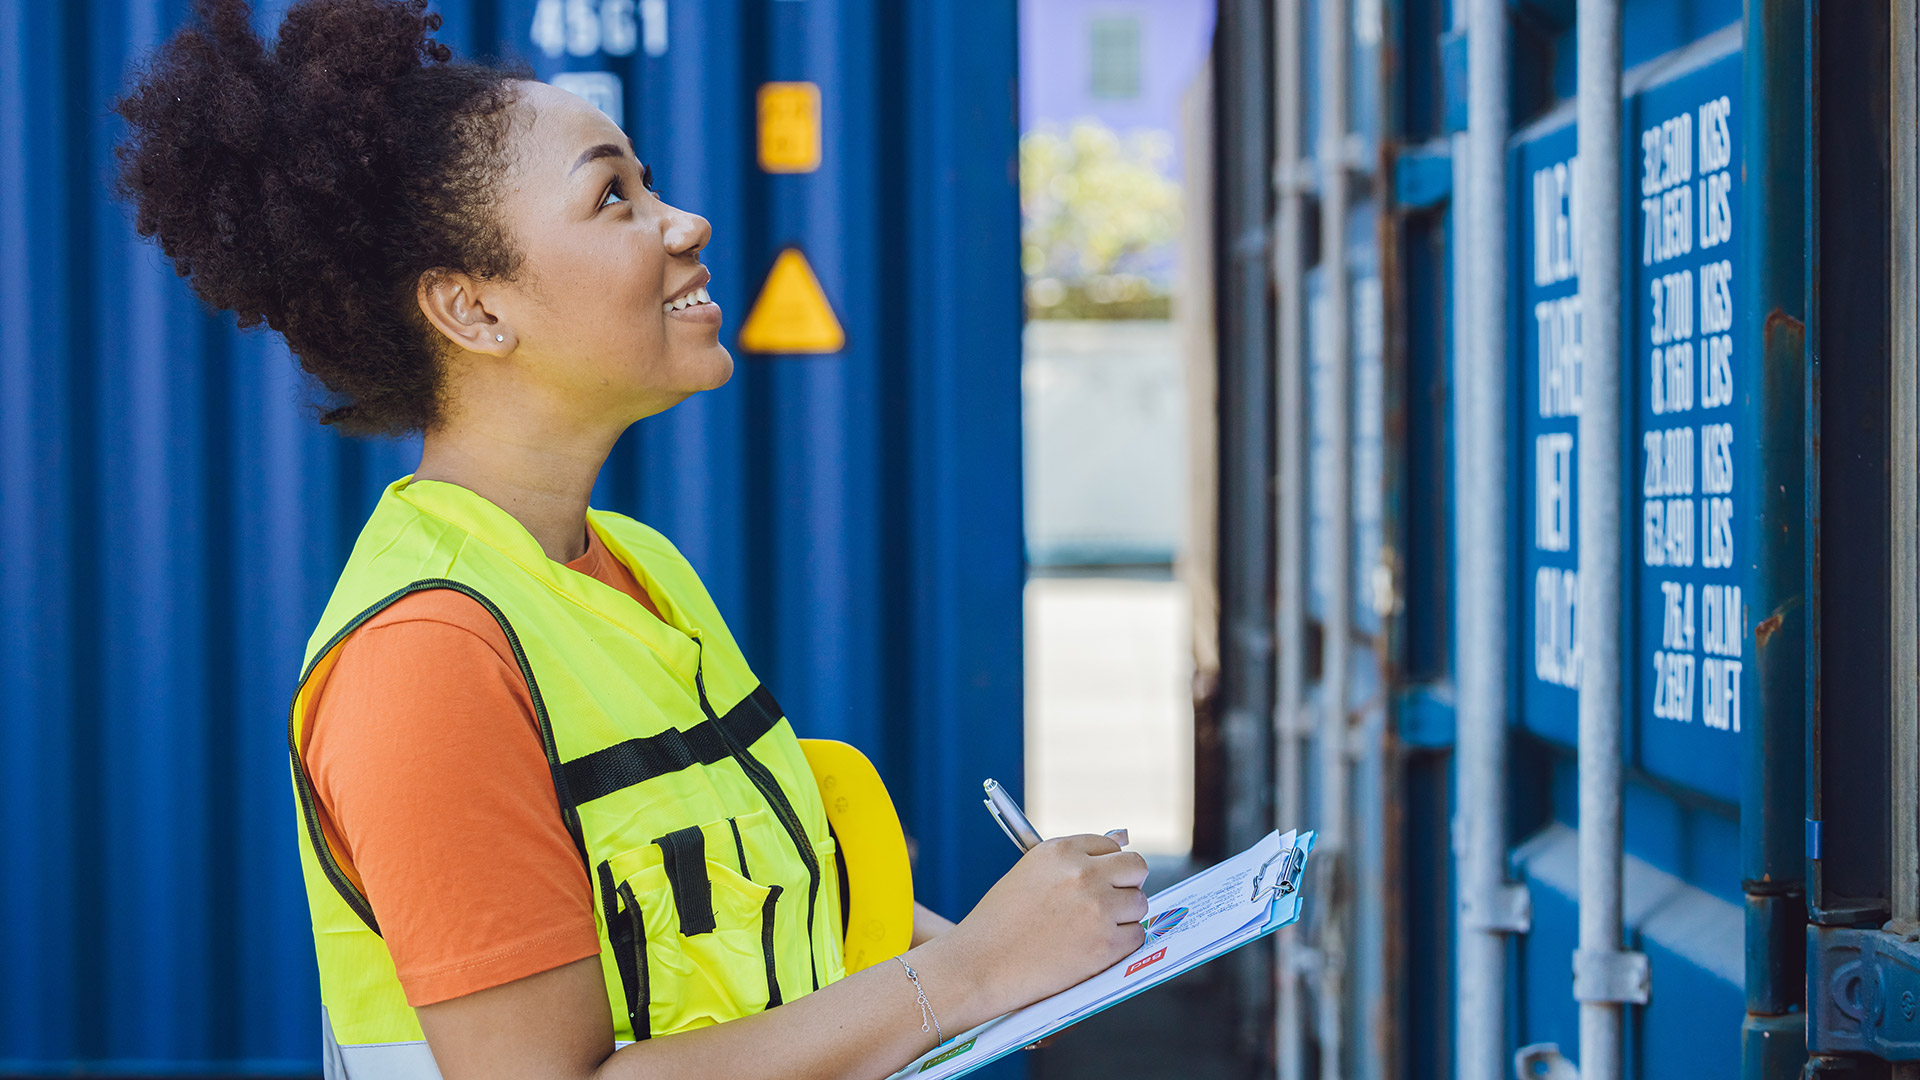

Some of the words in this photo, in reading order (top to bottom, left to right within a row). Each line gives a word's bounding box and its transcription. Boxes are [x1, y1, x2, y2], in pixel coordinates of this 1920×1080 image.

[1698, 95, 1731, 175] KGS
[1698, 171, 1732, 250] LBS
[1699, 259, 1733, 335] KGS
[1700, 334, 1733, 409] LBS
[1535, 432, 1574, 553] NET
[1701, 422, 1734, 494] KGS
[1701, 497, 1734, 568] LBS
[1128, 951, 1163, 972] Bad
[923, 1042, 973, 1069] Good
